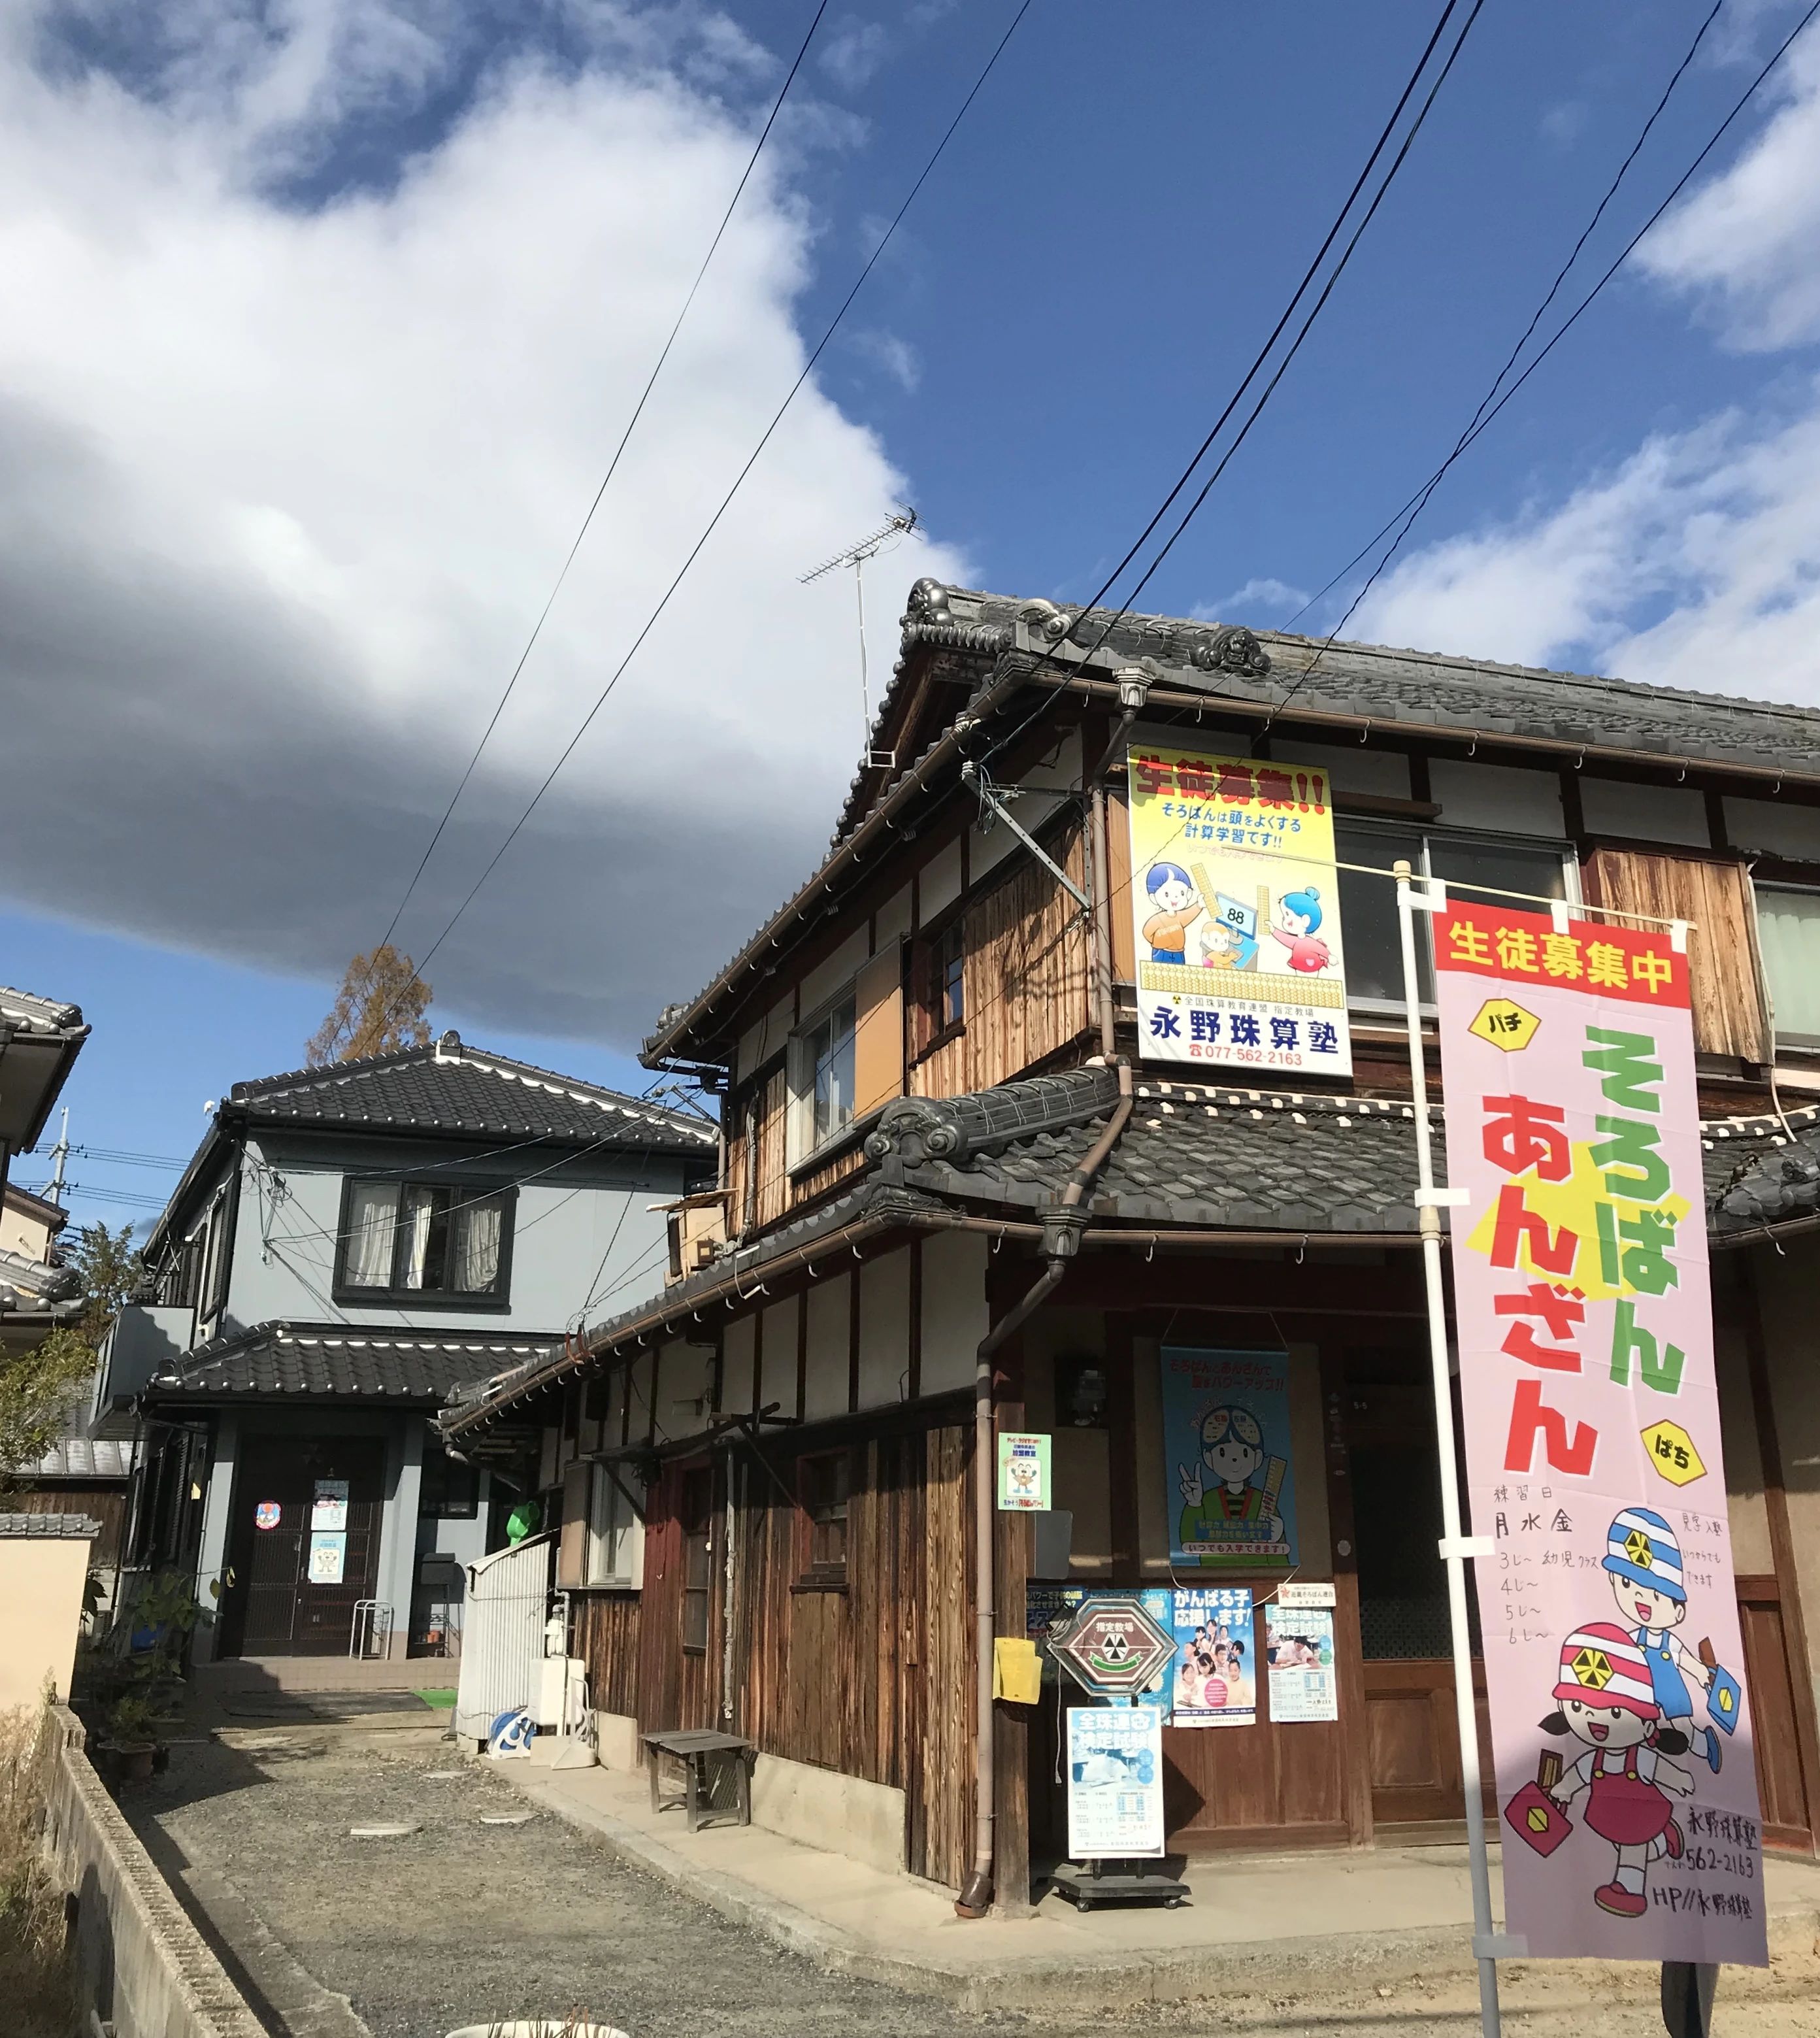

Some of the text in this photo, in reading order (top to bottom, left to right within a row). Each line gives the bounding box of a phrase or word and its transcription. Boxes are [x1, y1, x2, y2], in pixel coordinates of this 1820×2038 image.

[1136, 755, 1325, 815] 生徒募集!!
[1162, 803, 1301, 832] そろばんは頭をよくする
[1185, 823, 1282, 848] 計算学習です!!
[1227, 908, 1244, 924] 88
[1449, 921, 1673, 994] 生徒募集中
[1150, 1006, 1339, 1054] 永野珠算塾
[1488, 1013, 1522, 1034] パチ
[1205, 1046, 1302, 1065] 077-562-2163
[1582, 1024, 1686, 1397] そろばん
[1481, 1094, 1598, 1477] あんざん
[1655, 1434, 1690, 1470] ぱち
[1494, 1484, 1553, 1503] 練習日
[1496, 1508, 1573, 1539] 月水金
[1188, 1544, 1285, 1554] いつでも入学できます!
[1174, 1590, 1249, 1608] がんばる子
[1095, 1622, 1134, 1633] 指定教場
[1174, 1608, 1251, 1627] 応援します!
[1079, 1712, 1130, 1730] 全珠連
[1686, 1846, 1754, 1879] 562-2163
